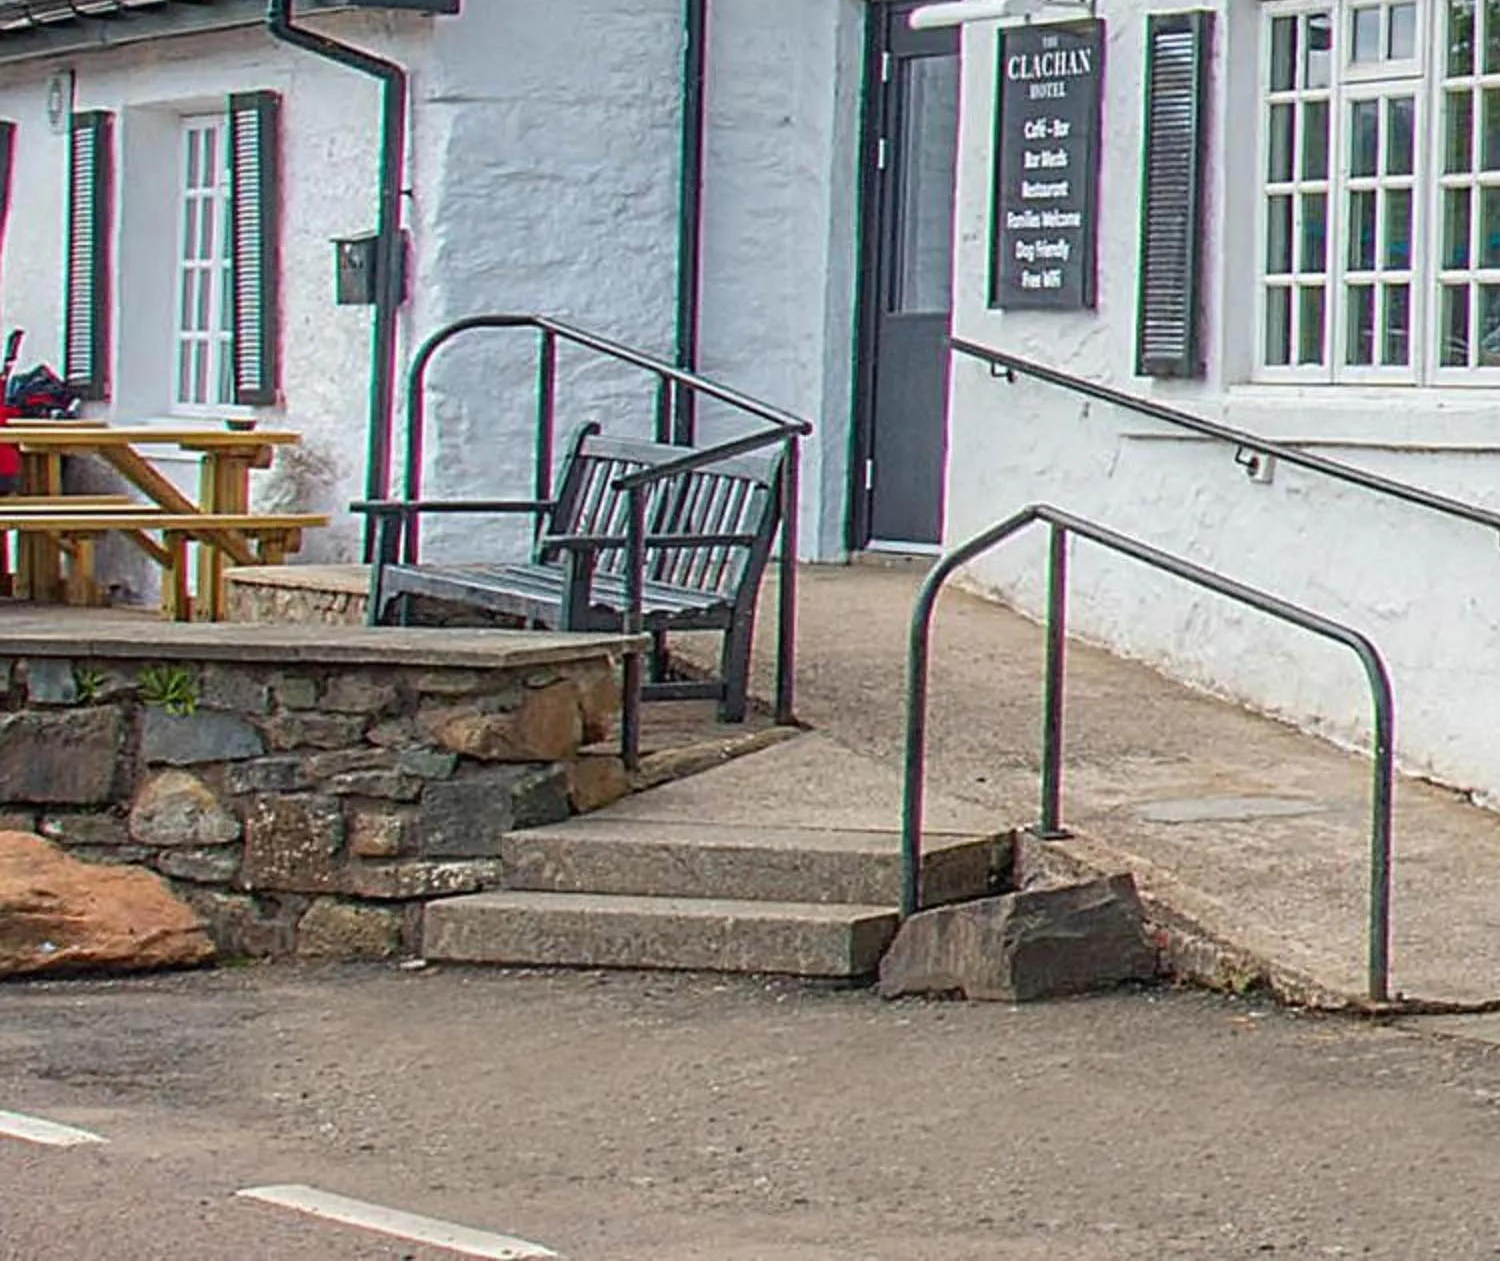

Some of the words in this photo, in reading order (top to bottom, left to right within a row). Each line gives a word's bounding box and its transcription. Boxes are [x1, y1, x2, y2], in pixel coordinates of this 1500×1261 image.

[1007, 48, 1091, 80] CLACHAN
[1029, 81, 1066, 99] HOTEL
[1015, 240, 1035, 262] Dog
[1035, 238, 1070, 261] Friendly
[1022, 270, 1041, 288] Free
